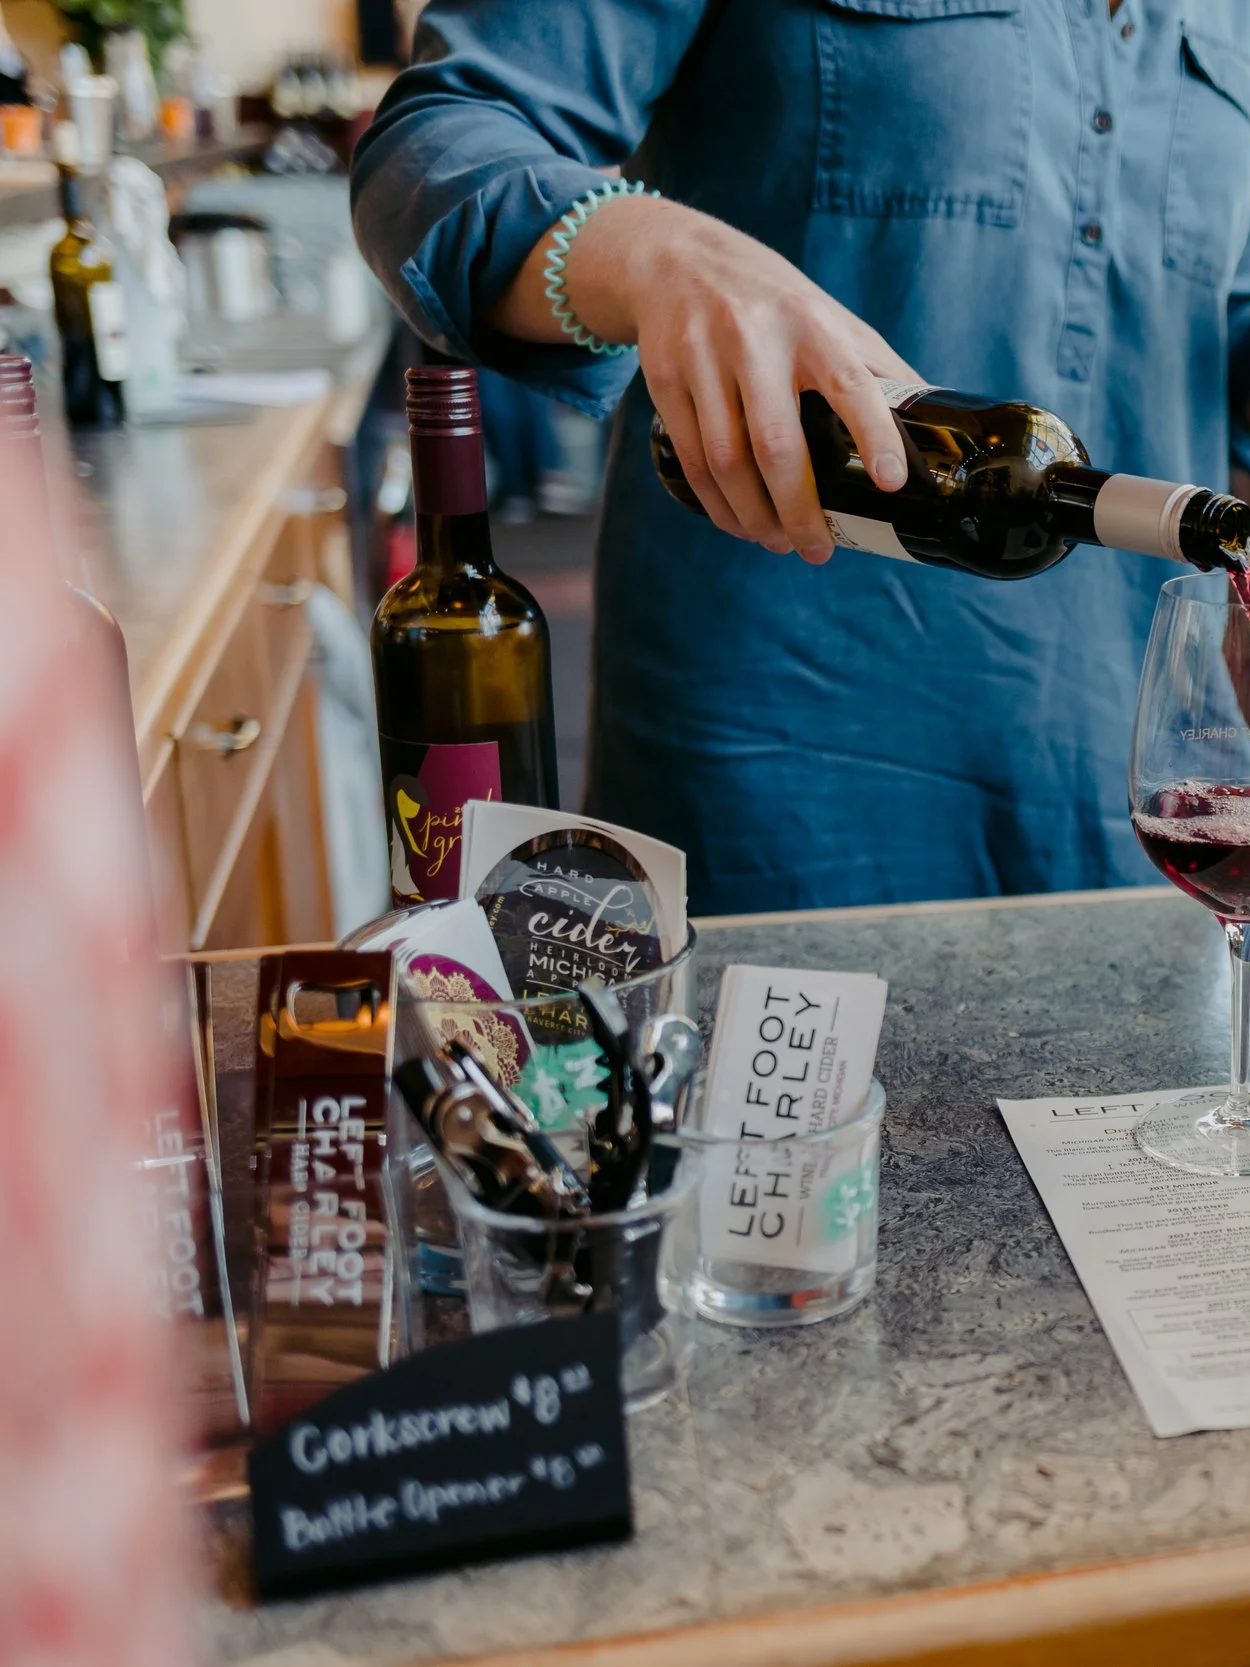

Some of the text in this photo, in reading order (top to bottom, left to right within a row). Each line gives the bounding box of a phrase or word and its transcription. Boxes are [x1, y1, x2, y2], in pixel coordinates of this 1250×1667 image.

[533, 884, 592, 907] APPLE
[537, 861, 594, 883] HARD
[519, 880, 641, 973] cider
[529, 953, 616, 987] MICHIGA
[746, 986, 790, 1106] FOOT
[817, 1037, 838, 1084] CIDER
[808, 1088, 828, 1133] HARD
[1051, 1102, 1145, 1117] LEFT
[289, 1201, 310, 1259] CIDER
[308, 1096, 341, 1306] CHARLEY
[337, 1096, 367, 1306] LEFT FOOT
[289, 1398, 511, 1473] Corkscrew
[279, 1492, 398, 1550] Bottle
[400, 1475, 526, 1523] Opener
